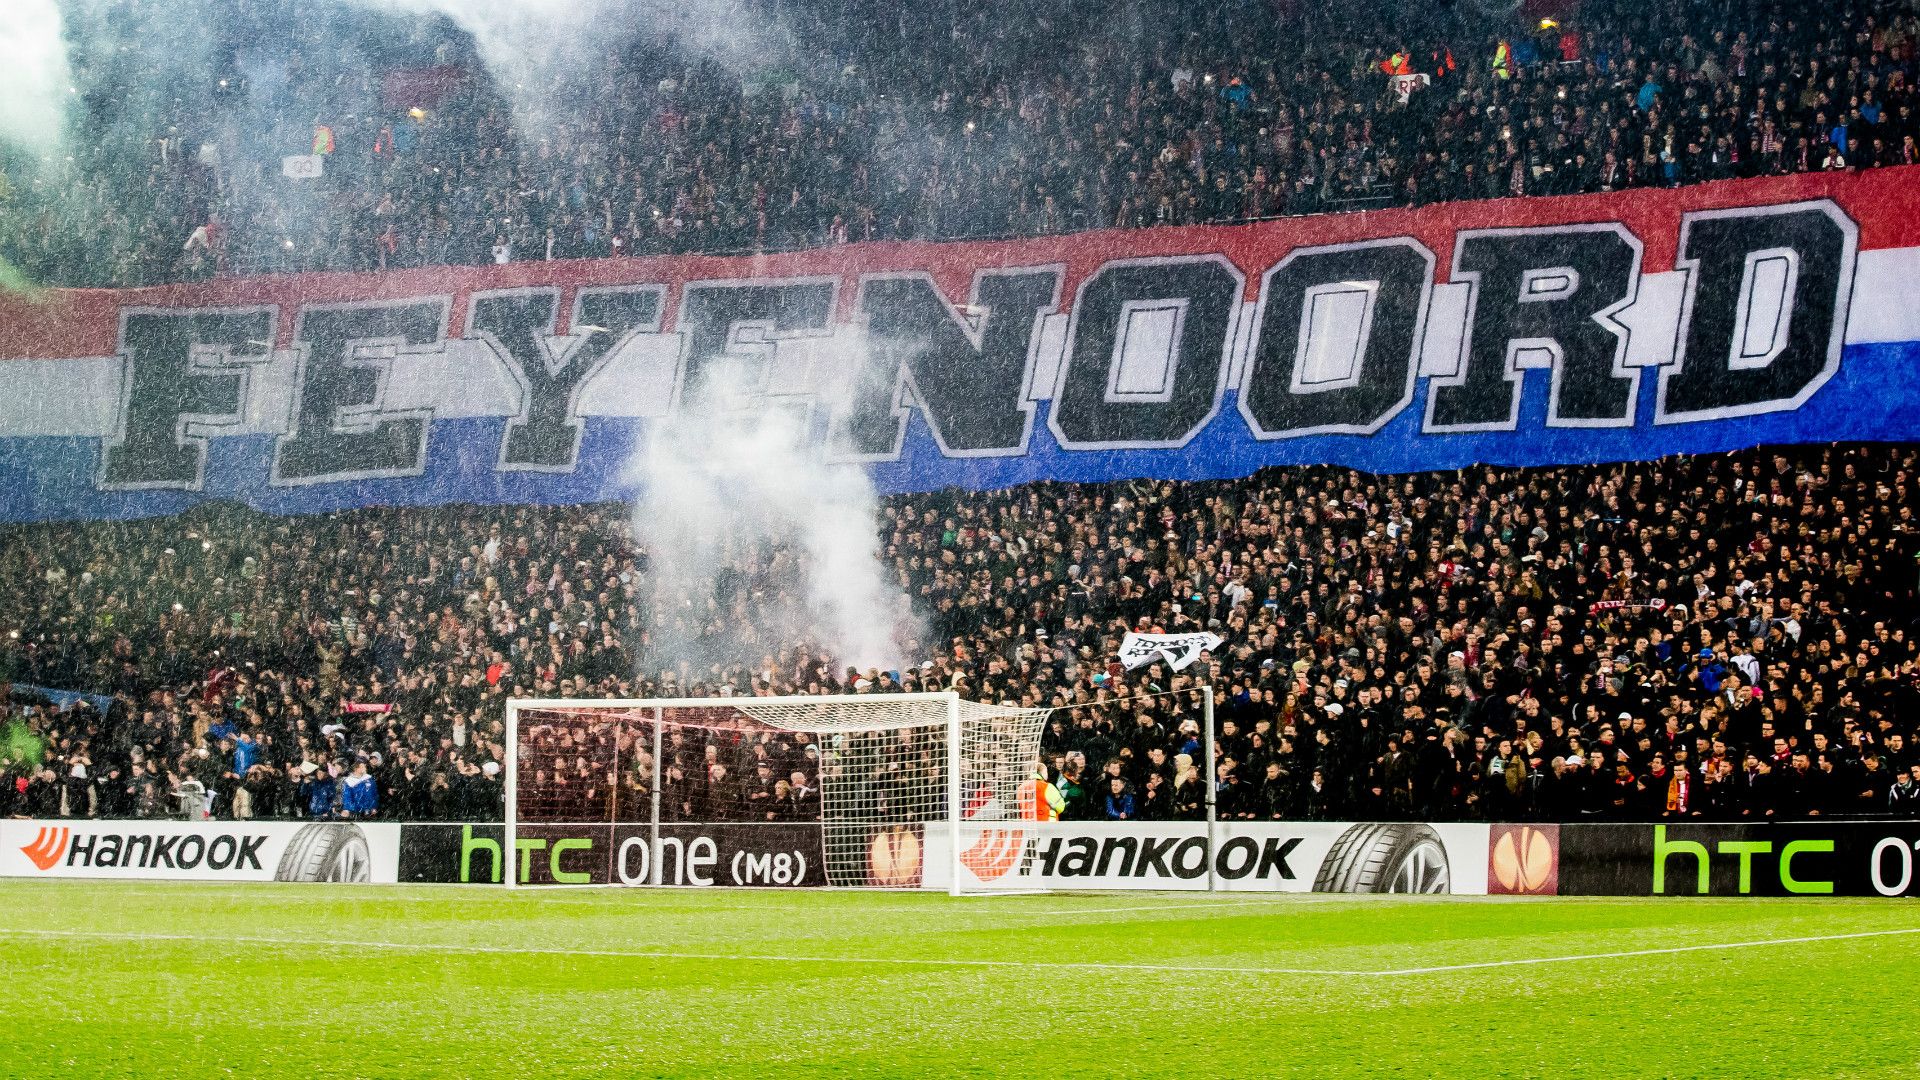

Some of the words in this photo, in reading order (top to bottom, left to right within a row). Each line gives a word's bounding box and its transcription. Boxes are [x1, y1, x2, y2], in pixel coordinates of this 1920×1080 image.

[97, 198, 1859, 492] FEYENOORD
[617, 836, 718, 887] one
[731, 850, 807, 887] (M8)
[1870, 836, 1920, 897] o
